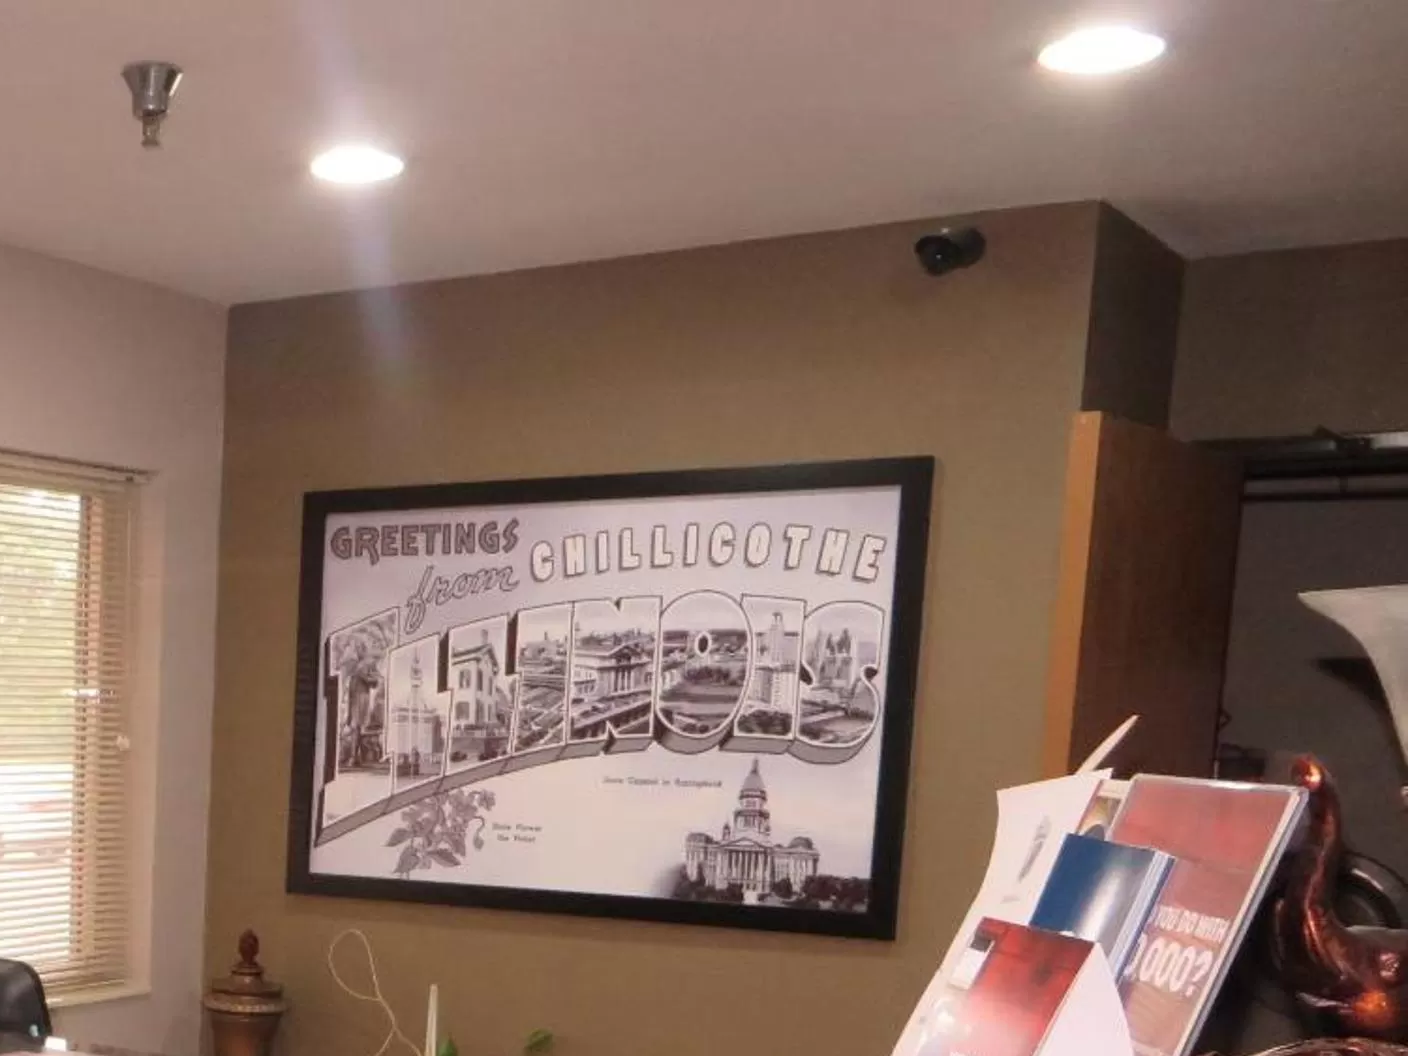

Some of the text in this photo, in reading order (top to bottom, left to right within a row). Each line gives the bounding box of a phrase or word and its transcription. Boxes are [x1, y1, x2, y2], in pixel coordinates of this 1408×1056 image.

[330, 517, 520, 566] GREETINGS
[528, 521, 887, 584] CHILLICOTHE
[405, 563, 521, 637] from
[316, 590, 886, 846] ILLINOIS
[1176, 908, 1200, 934] DO
[1194, 914, 1233, 944] WITH
